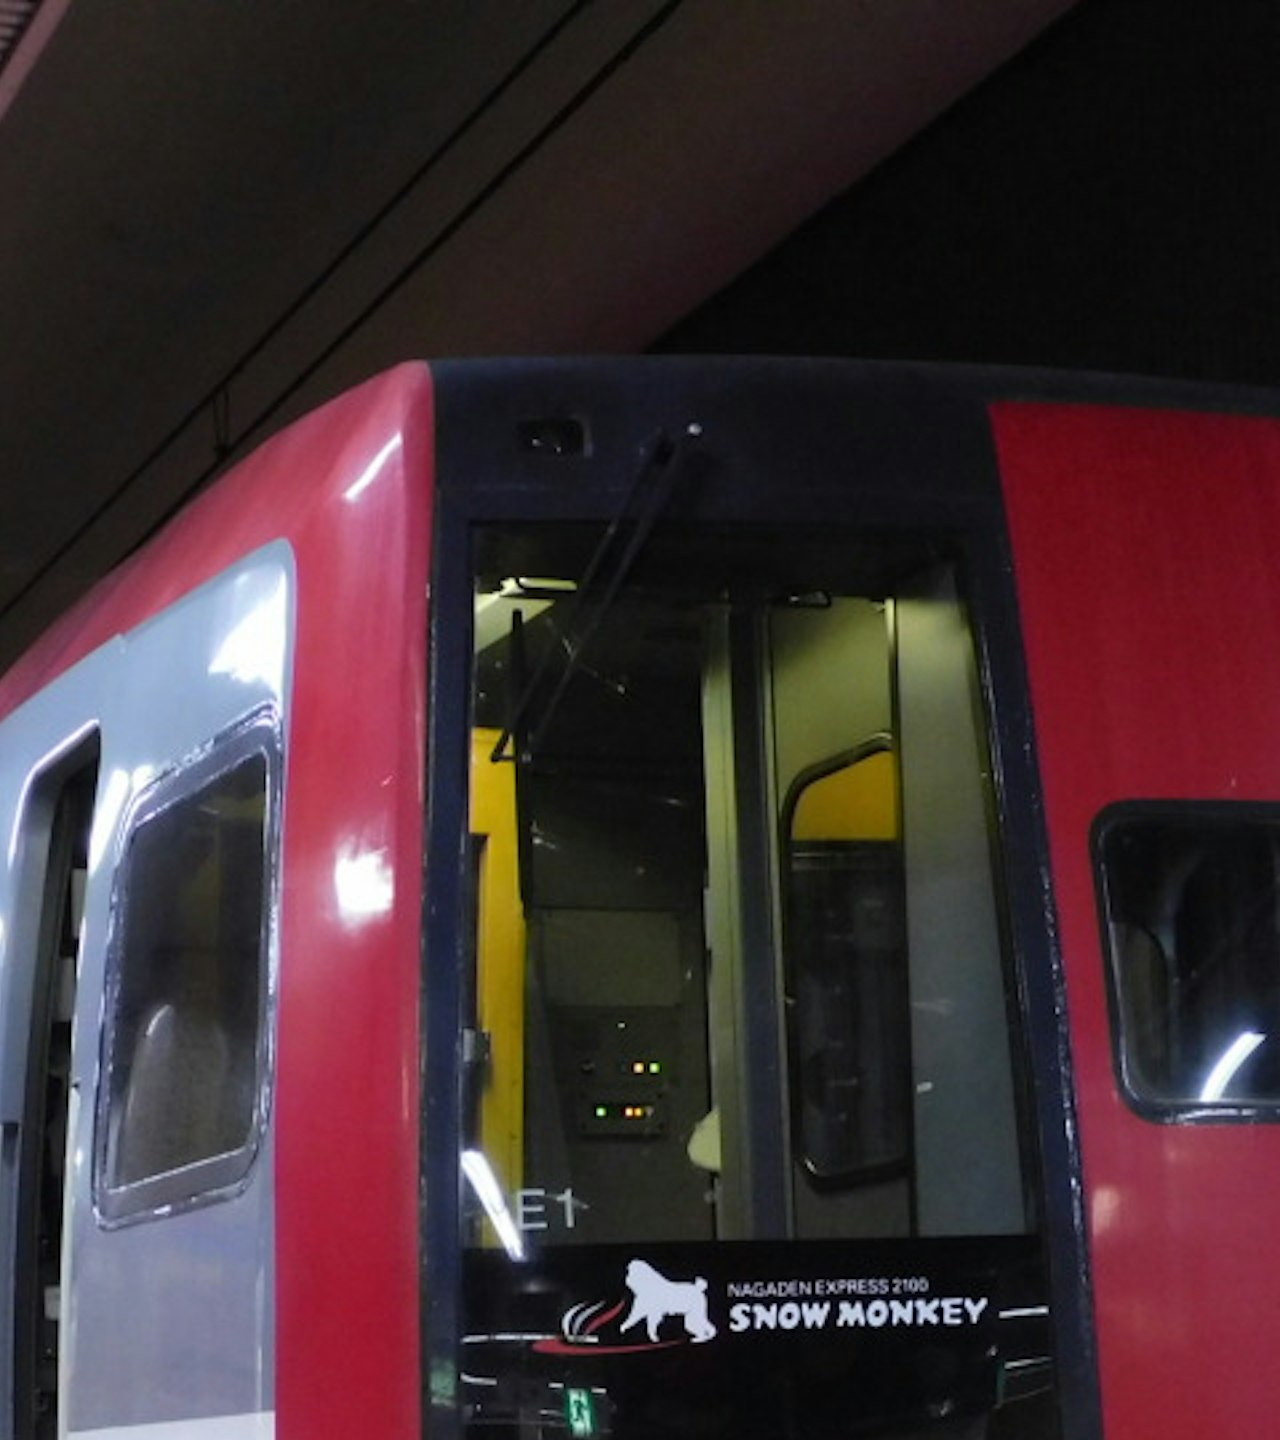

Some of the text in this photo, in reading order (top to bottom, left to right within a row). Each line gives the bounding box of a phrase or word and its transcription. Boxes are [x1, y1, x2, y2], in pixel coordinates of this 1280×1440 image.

[516, 1187, 575, 1231] E1
[727, 1276, 930, 1298] NAGADEN EXPRESS 2100
[729, 1297, 988, 1332] SNOW MONKEY
